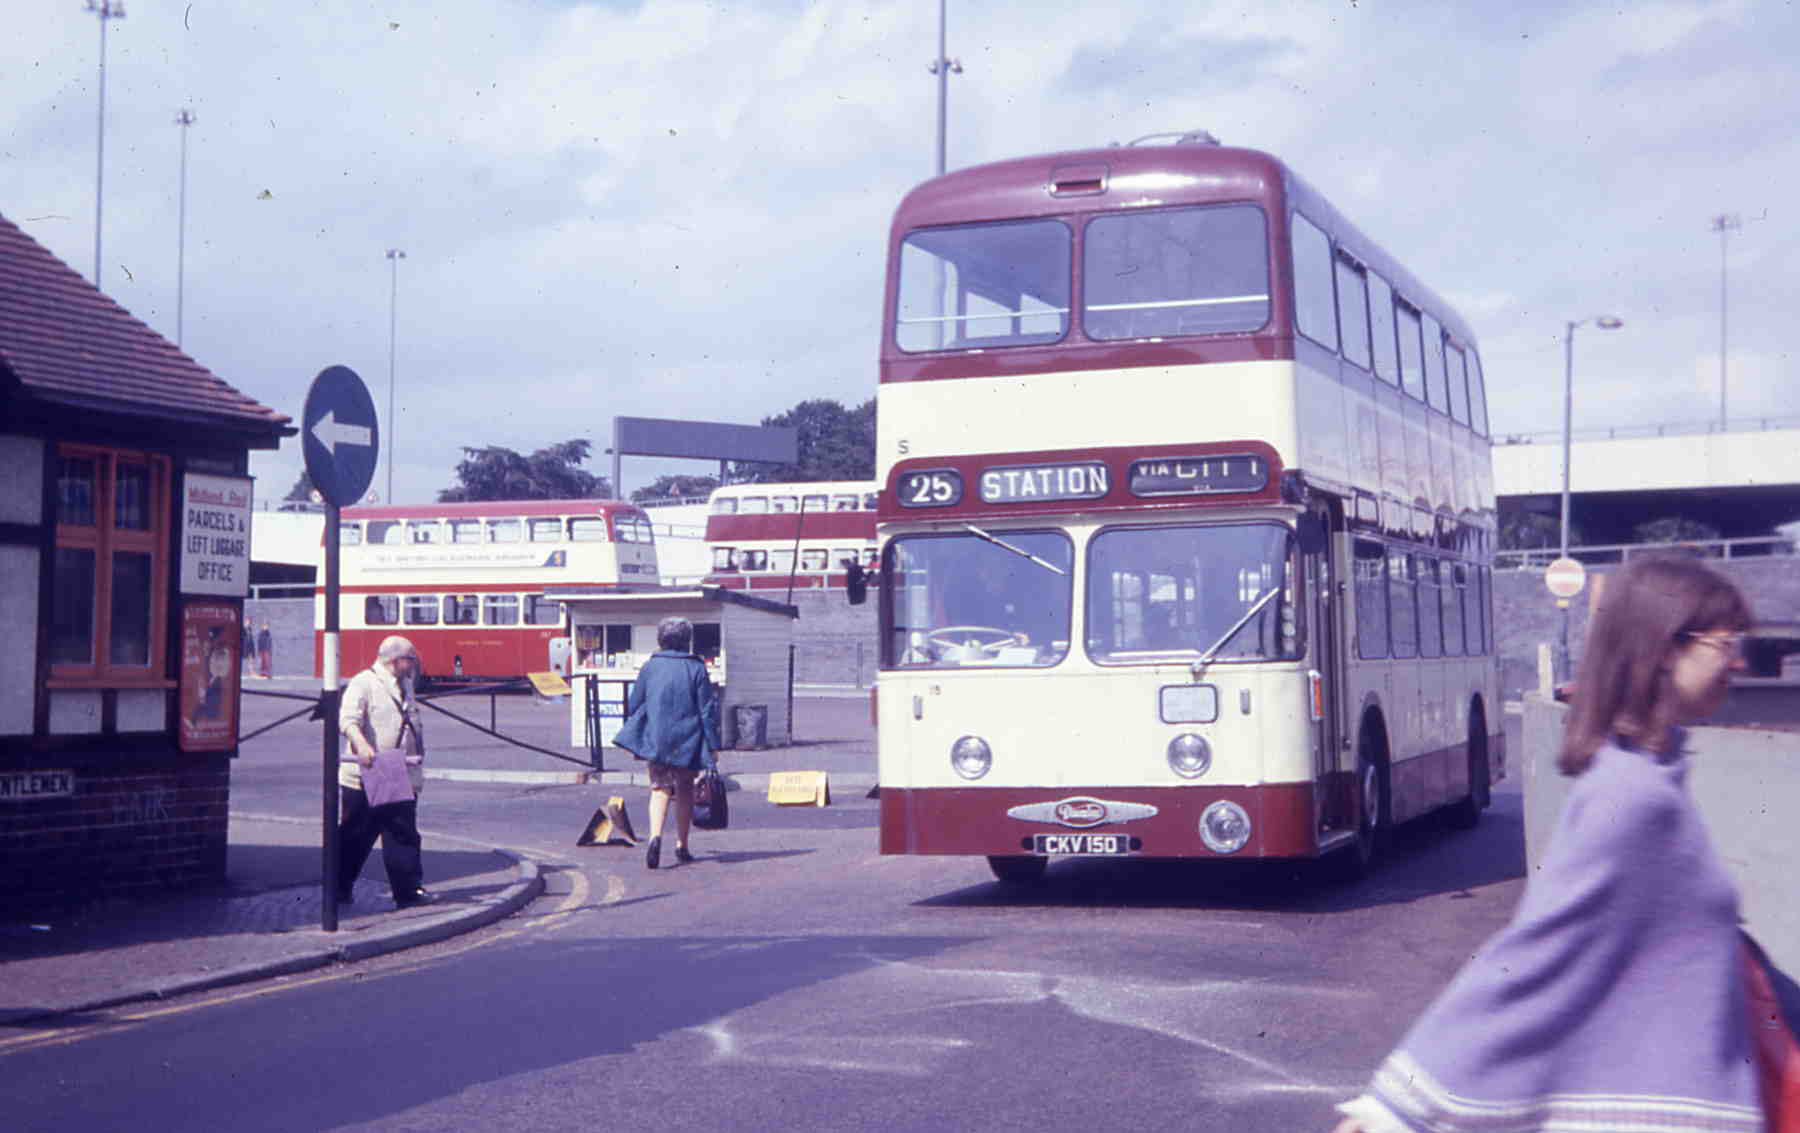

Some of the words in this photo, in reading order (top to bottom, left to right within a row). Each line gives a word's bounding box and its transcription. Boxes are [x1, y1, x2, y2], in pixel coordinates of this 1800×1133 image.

[898, 440, 909, 454] S
[1138, 462, 1169, 477] VIA
[910, 475, 954, 503] 25
[982, 466, 1108, 500] STATION
[187, 509, 235, 532] PARCELS
[187, 535, 208, 555] LEFT
[198, 560, 233, 582] OFFICE
[1045, 836, 1083, 853] CKV
